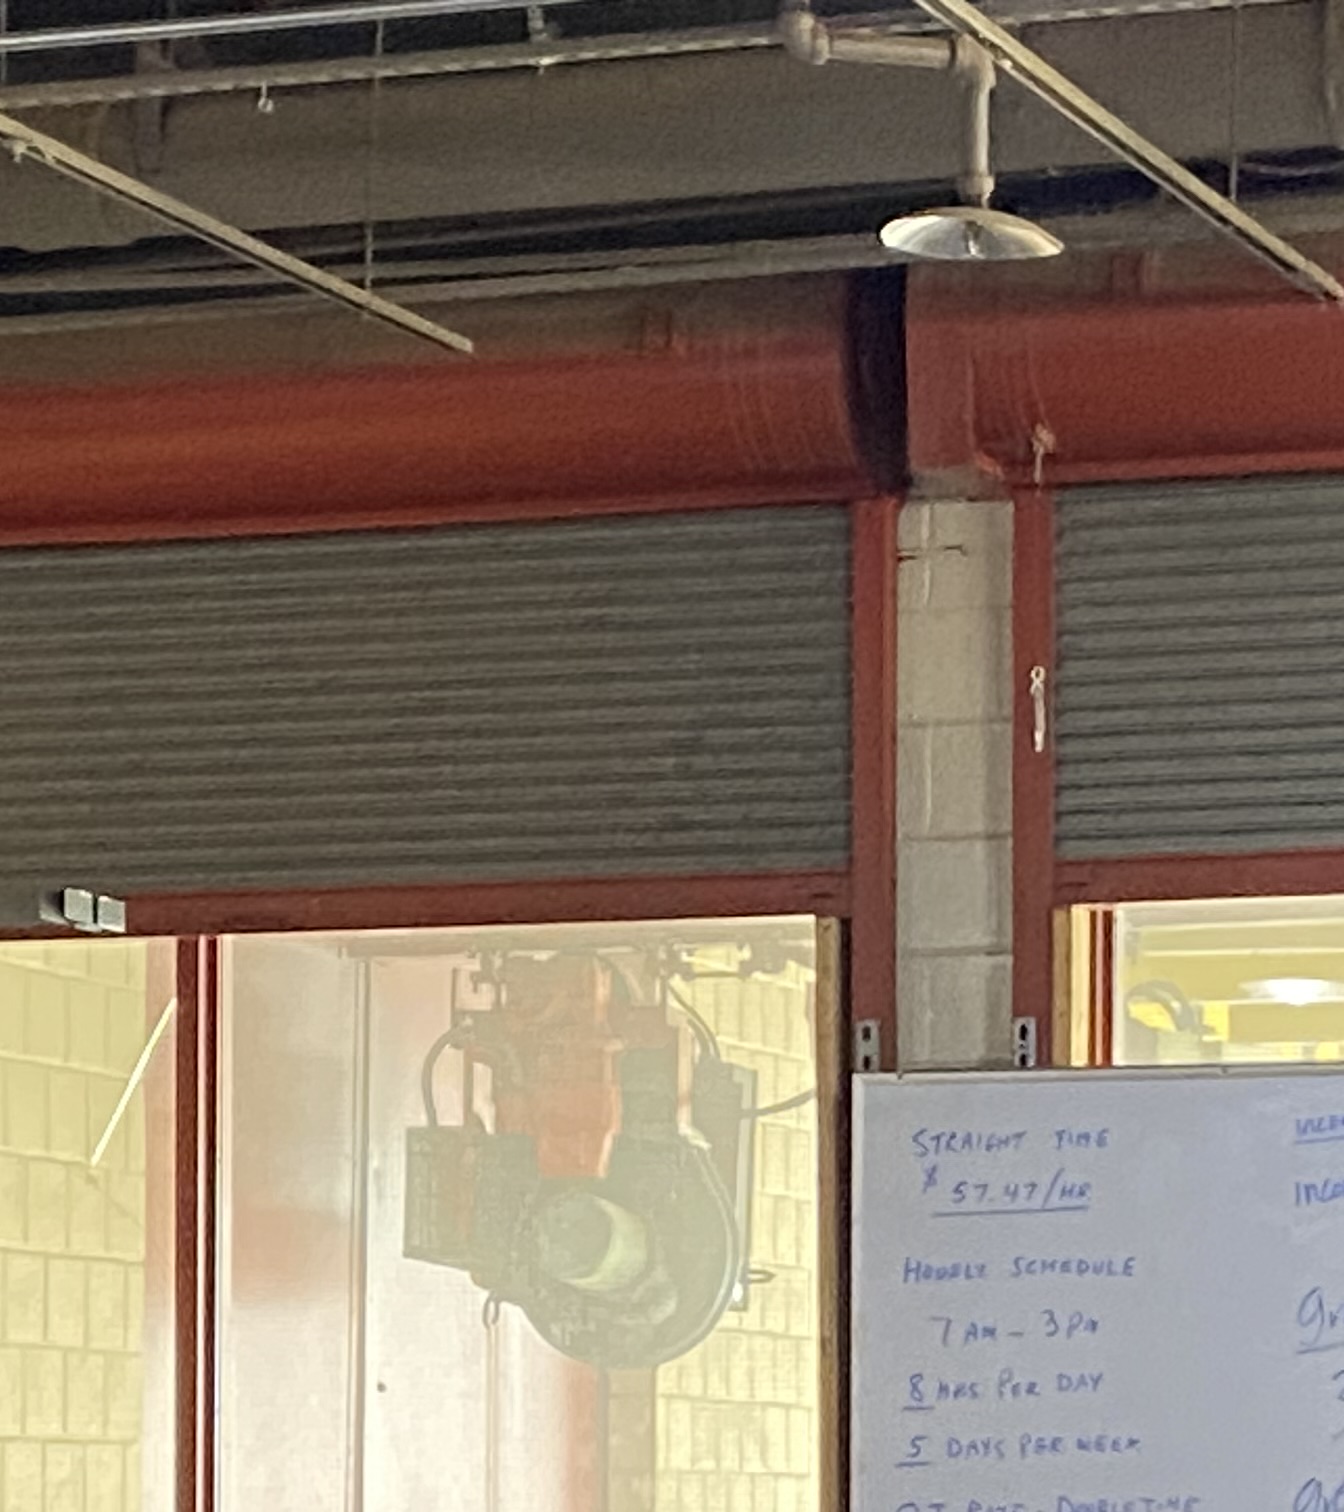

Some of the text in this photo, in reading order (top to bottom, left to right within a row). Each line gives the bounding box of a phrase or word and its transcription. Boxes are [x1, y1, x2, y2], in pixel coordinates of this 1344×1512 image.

[911, 1128, 1110, 1158] STRAIGHT TIME
[1009, 1255, 1137, 1279] SCHEDULE
[908, 1372, 925, 1402] 8
[1056, 1371, 1105, 1393] DAY
[907, 1435, 929, 1459] 5
[945, 1436, 1005, 1460] DAYS
[1018, 1433, 1064, 1460] PER
